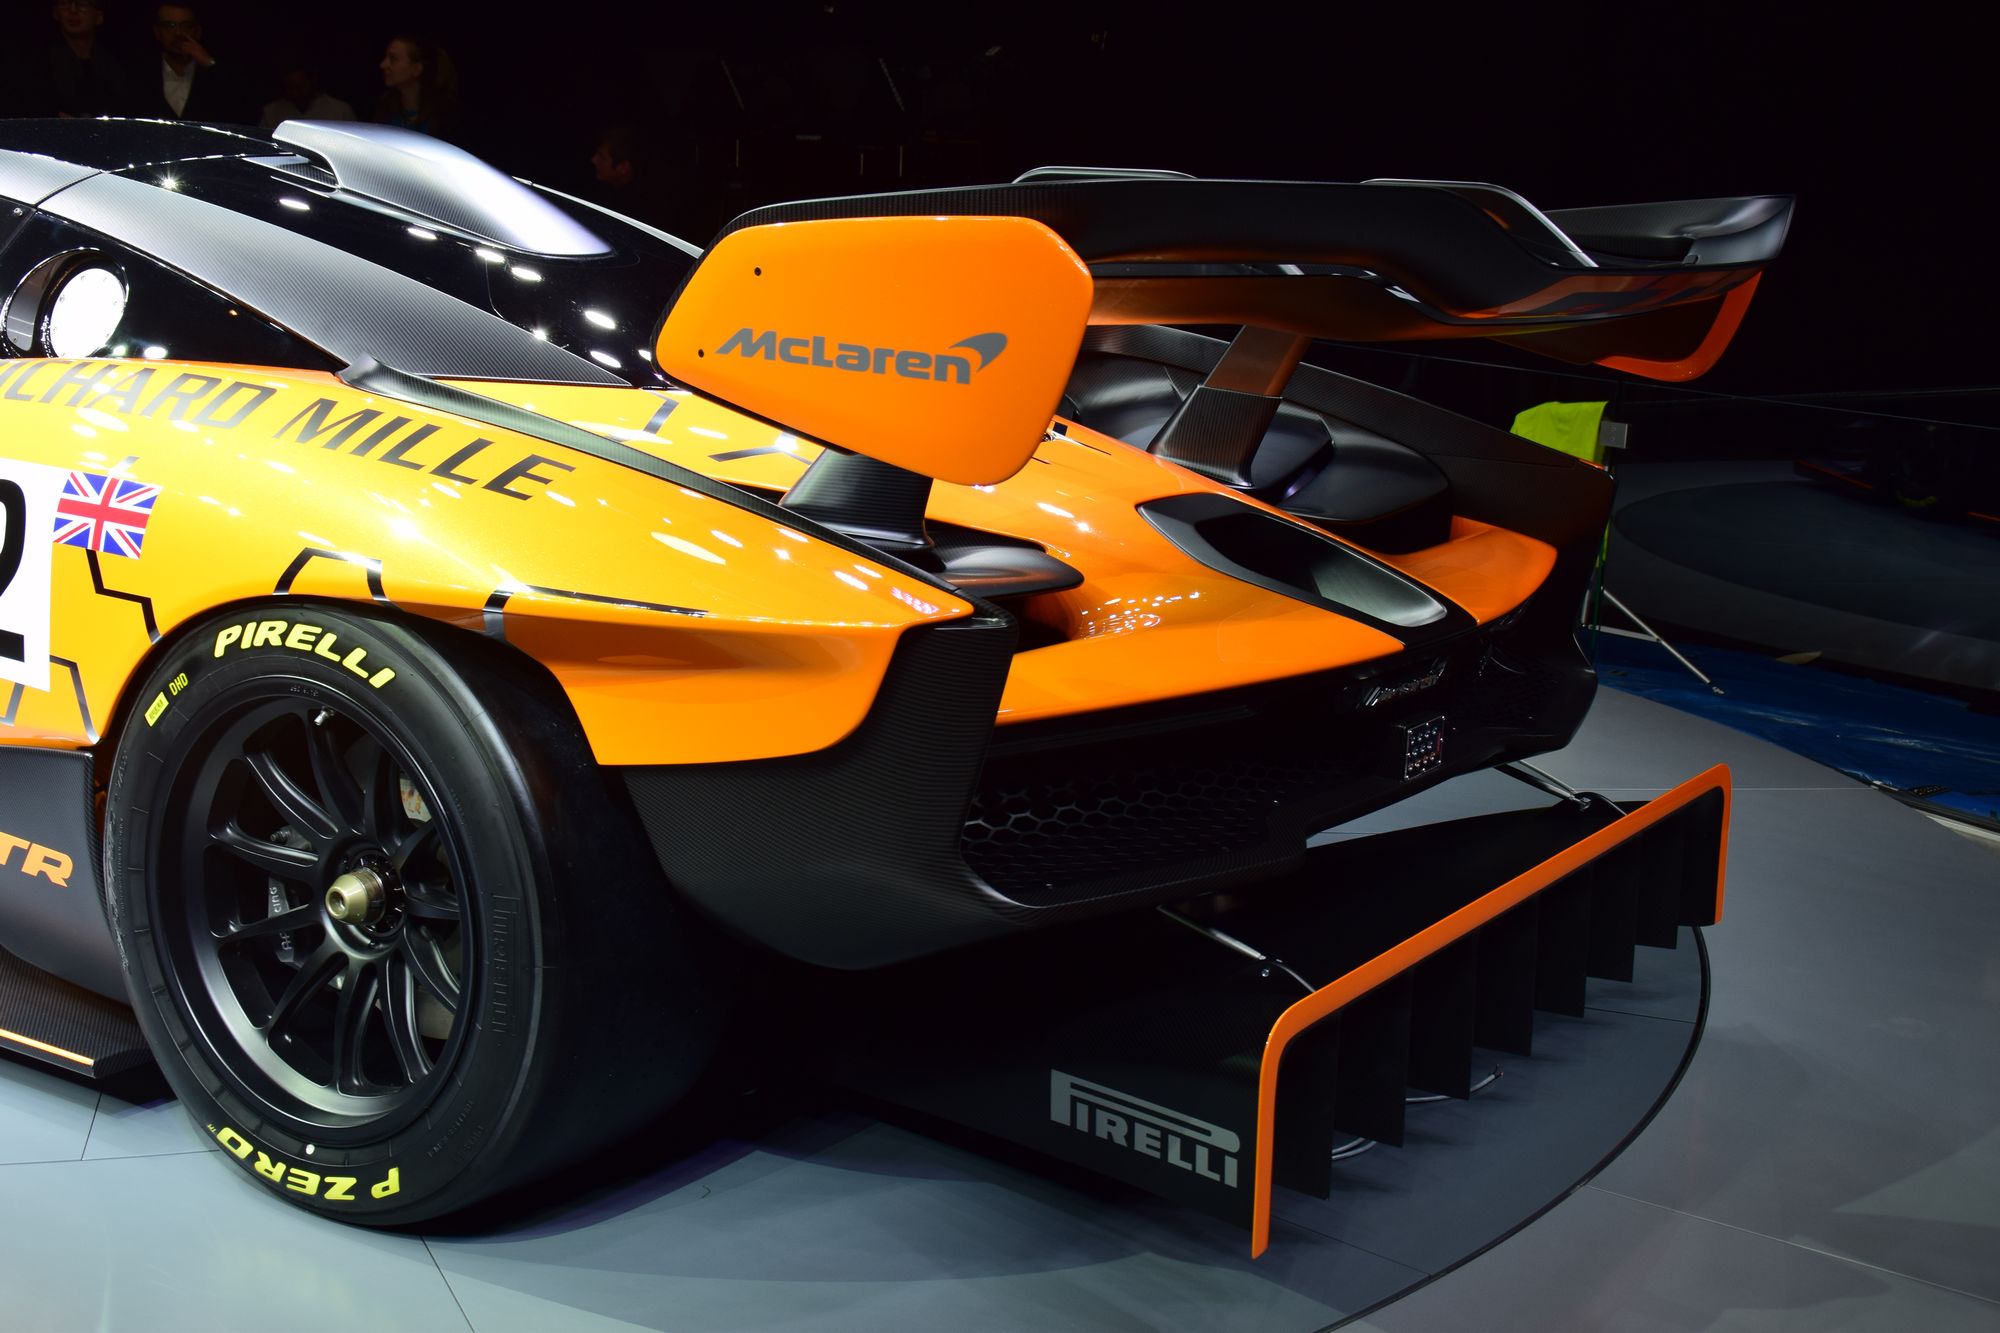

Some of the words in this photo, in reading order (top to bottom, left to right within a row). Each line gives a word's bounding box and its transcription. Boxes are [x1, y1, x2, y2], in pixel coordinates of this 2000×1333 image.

[714, 328, 971, 385] McLaren
[0, 358, 278, 430] ICHARD
[273, 397, 576, 501] MILLE
[169, 672, 189, 696] DHD
[213, 619, 397, 690] PIRELLI
[216, 1126, 358, 1201] ZERO
[1050, 1068, 1241, 1189] PIRELLI
[371, 1166, 400, 1200] P
